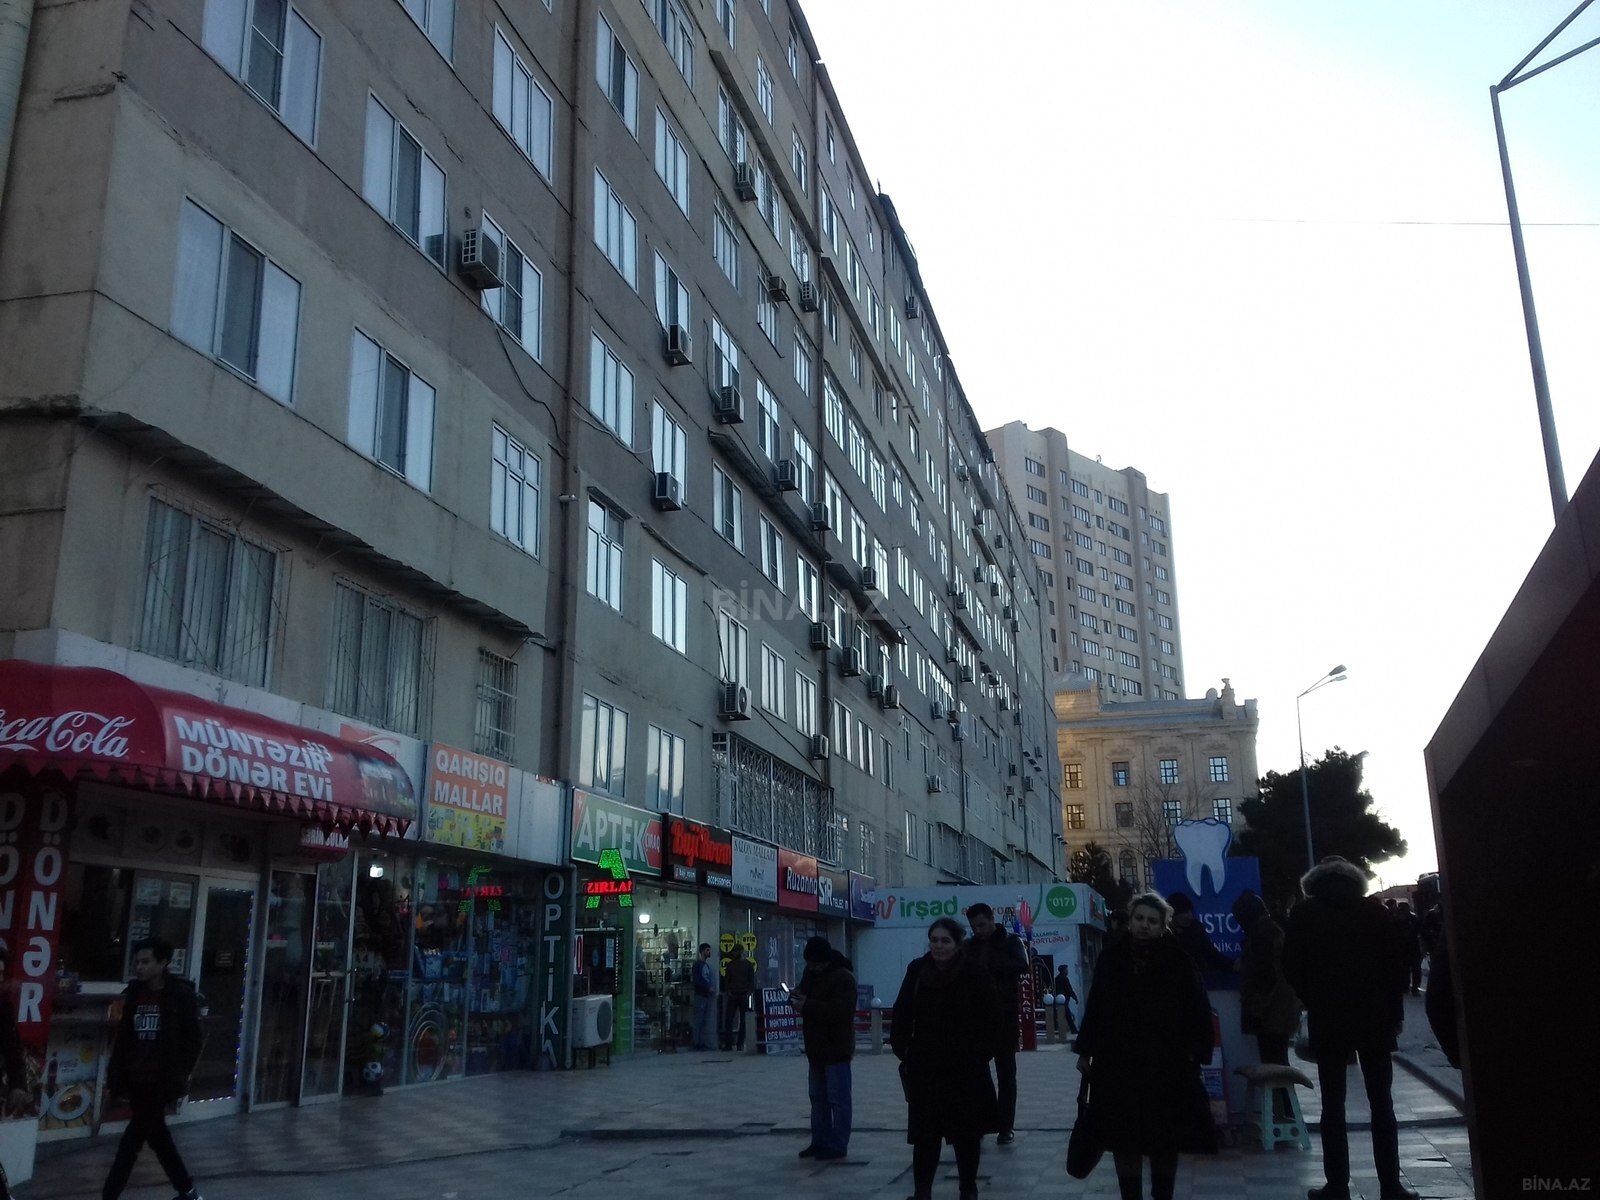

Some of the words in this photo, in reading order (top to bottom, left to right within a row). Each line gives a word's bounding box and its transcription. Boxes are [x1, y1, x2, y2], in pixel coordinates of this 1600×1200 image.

[46, 711, 136, 758] Cola
[174, 716, 329, 774] MÜNTƏZİR
[181, 745, 289, 793] DÖNƏR
[294, 771, 334, 802] EVİ
[436, 749, 506, 789] QARIŞIQ
[434, 780, 503, 816] MALLAR
[577, 805, 647, 862] APTEK
[786, 866, 818, 895] Ruzanna
[17, 793, 69, 1023] DÖNƏR
[900, 896, 958, 919] irşad
[1210, 939, 1243, 952] NİKA
